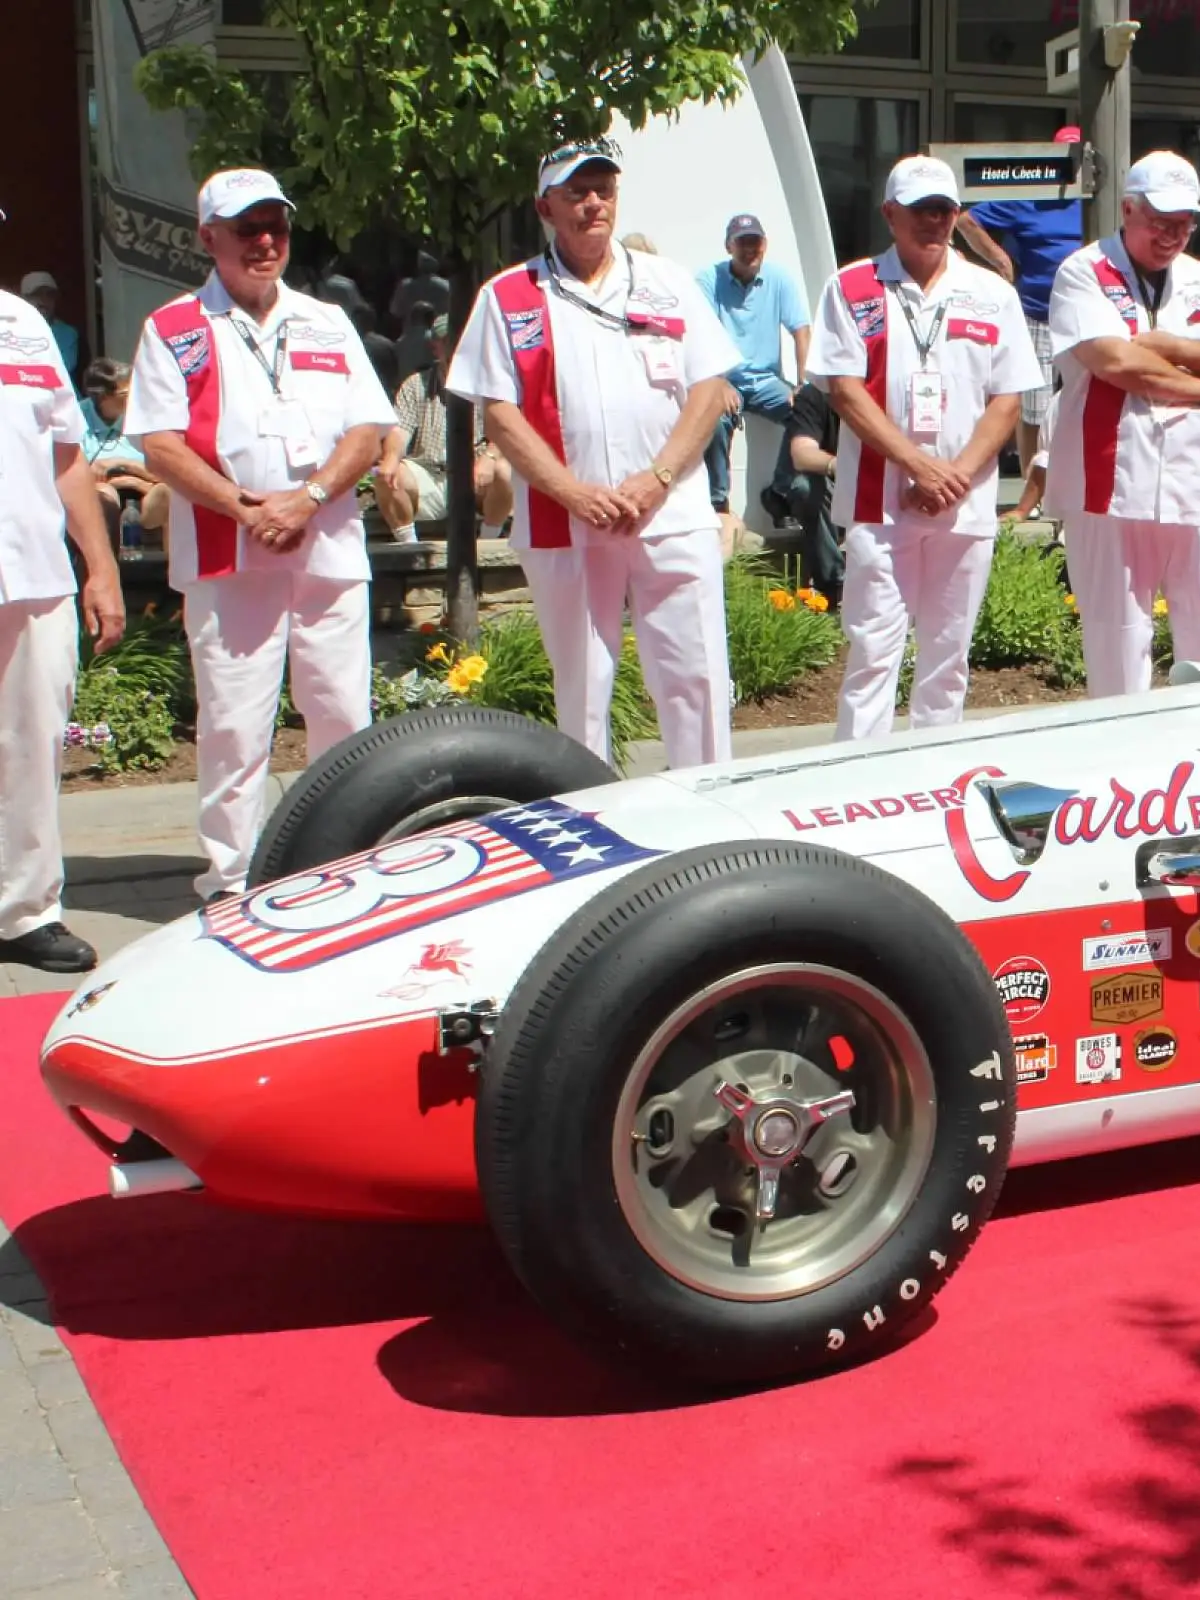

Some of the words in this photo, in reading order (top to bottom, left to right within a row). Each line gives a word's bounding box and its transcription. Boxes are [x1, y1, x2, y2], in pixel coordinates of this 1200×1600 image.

[981, 165, 1010, 180] Hotel
[1011, 165, 1041, 180] Check
[1044, 166, 1056, 179] In
[781, 787, 967, 832] LEADER
[1091, 941, 1162, 961] SUNNEN
[1093, 981, 1161, 1008] PREMIER
[1079, 1036, 1112, 1052] BOWES
[827, 1050, 1005, 1350] Firestone
